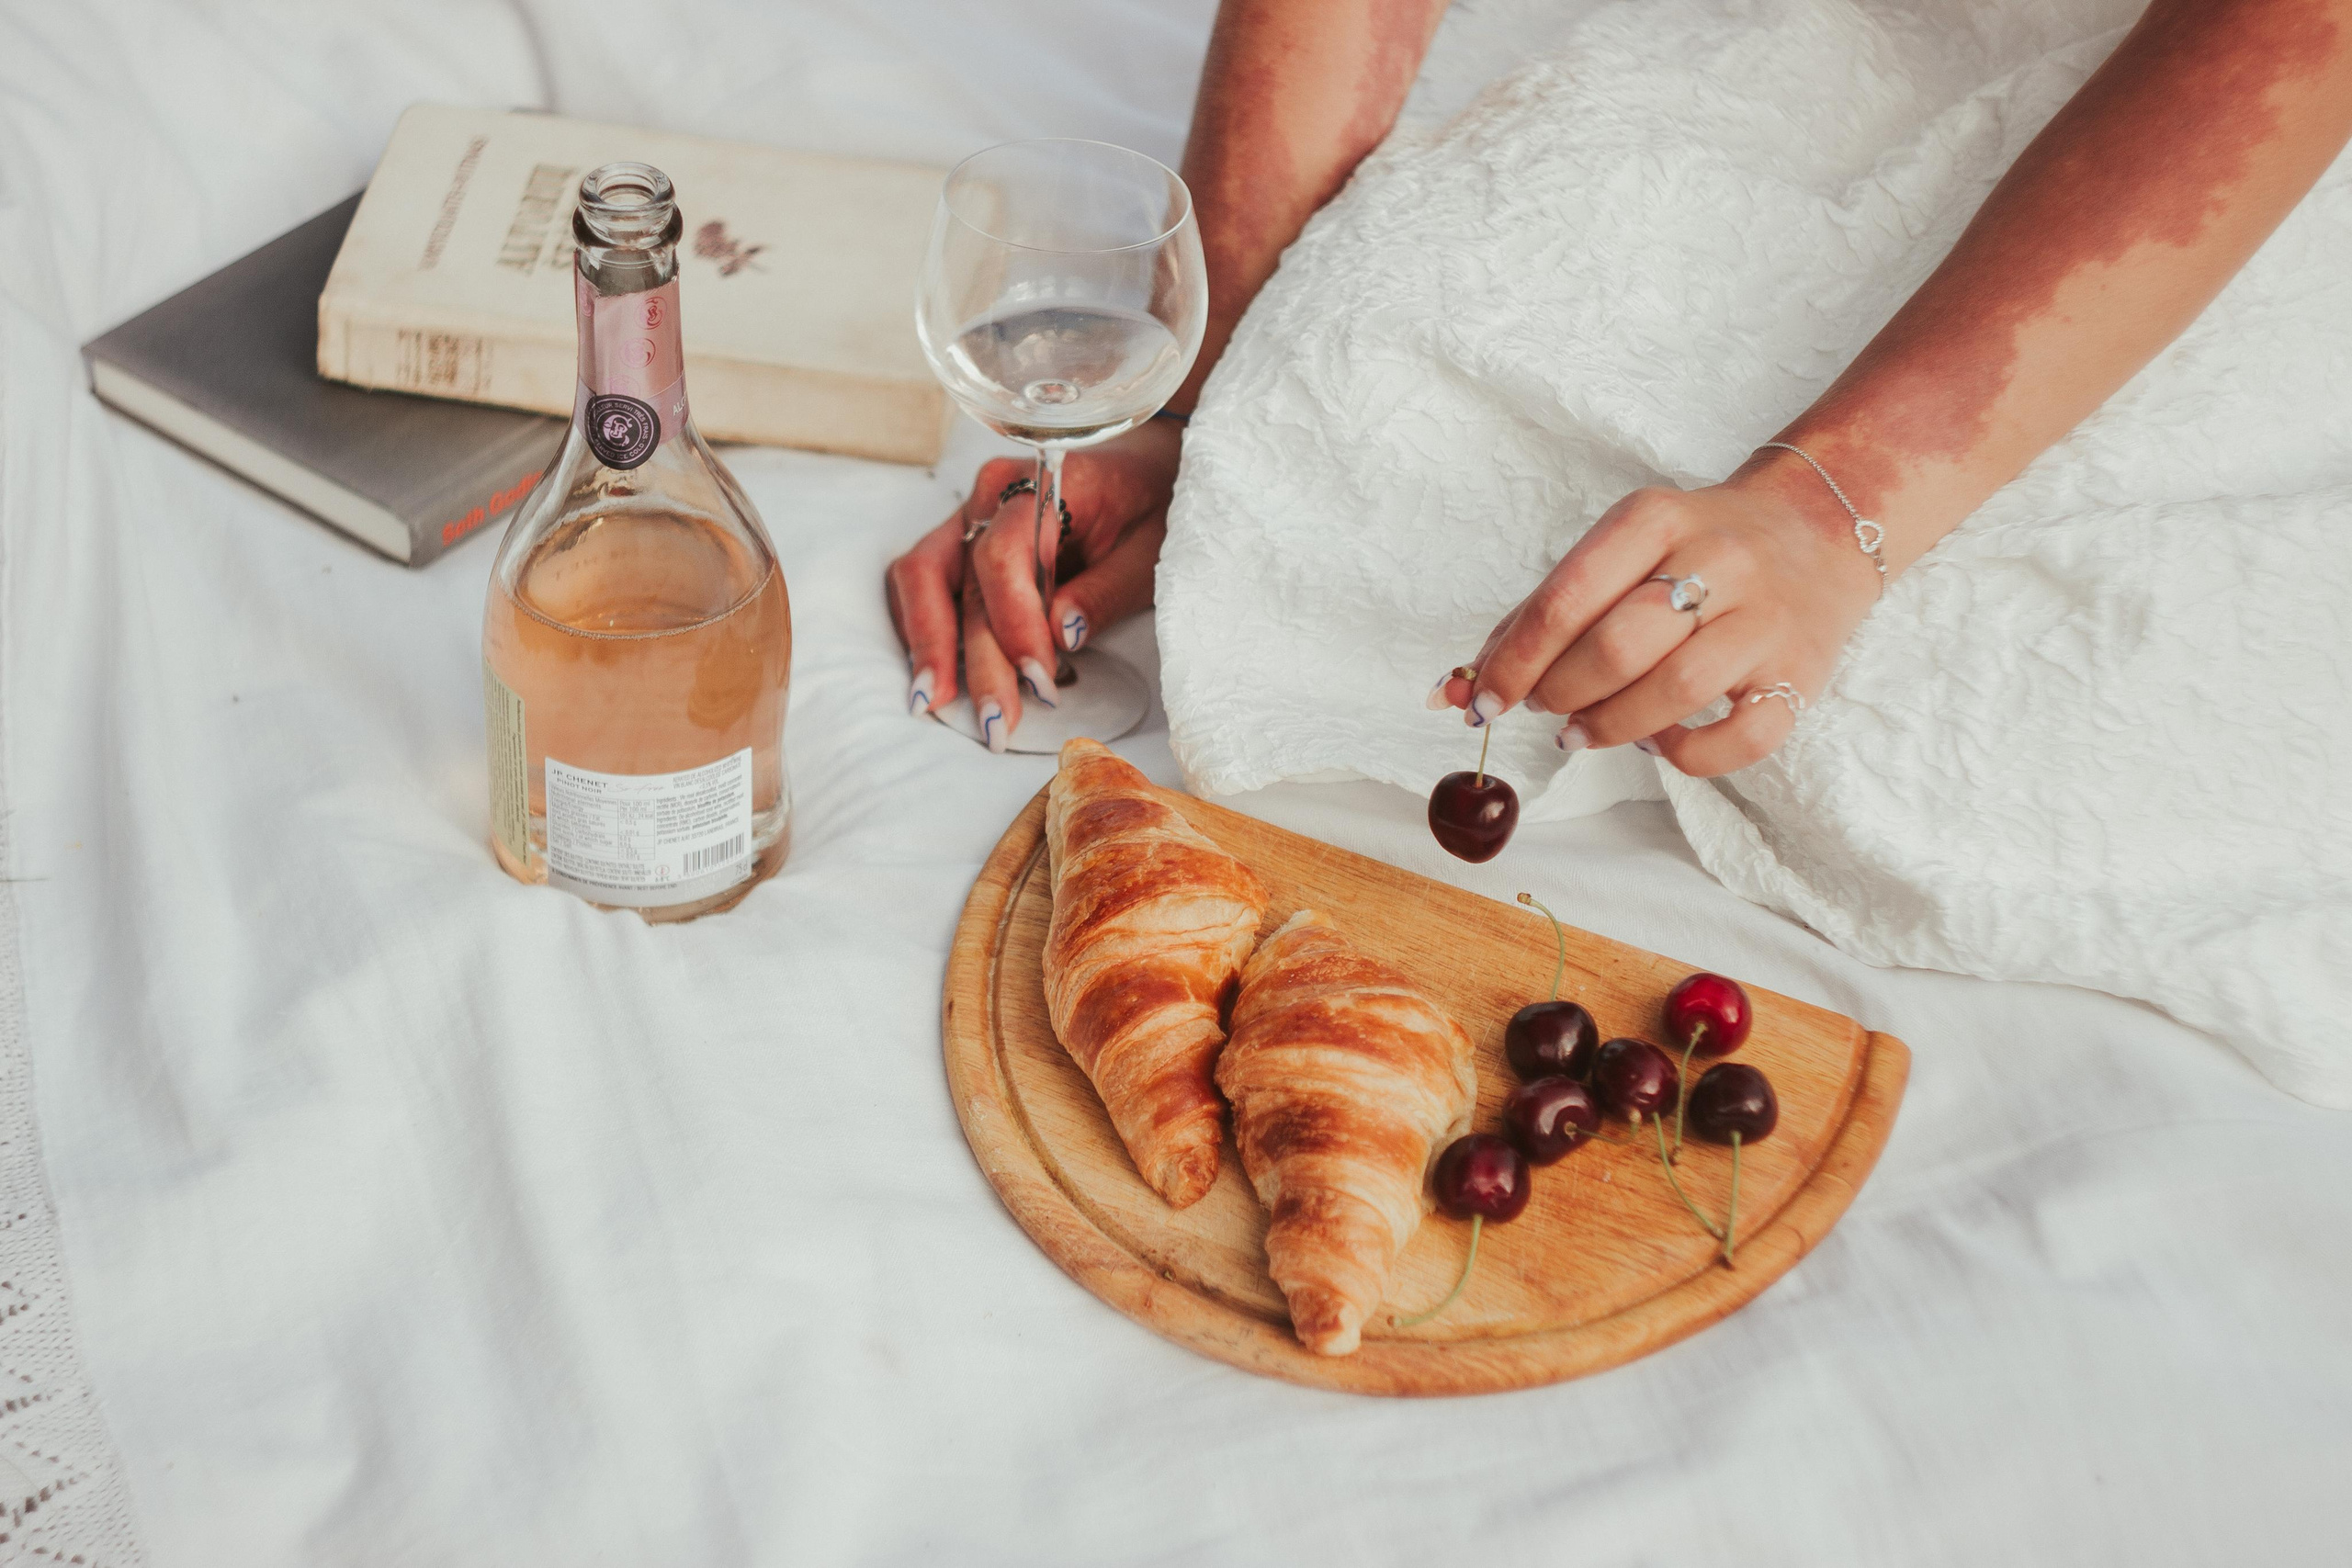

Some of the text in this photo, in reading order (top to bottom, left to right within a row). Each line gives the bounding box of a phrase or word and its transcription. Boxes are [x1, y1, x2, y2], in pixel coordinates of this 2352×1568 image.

[615, 402, 634, 412] SERVI
[642, 421, 654, 440] FRAIS
[628, 443, 645, 457] COLD
[551, 768, 608, 788] JP CHENET
[557, 777, 579, 789] PINOT
[582, 786, 603, 795] NOIR
